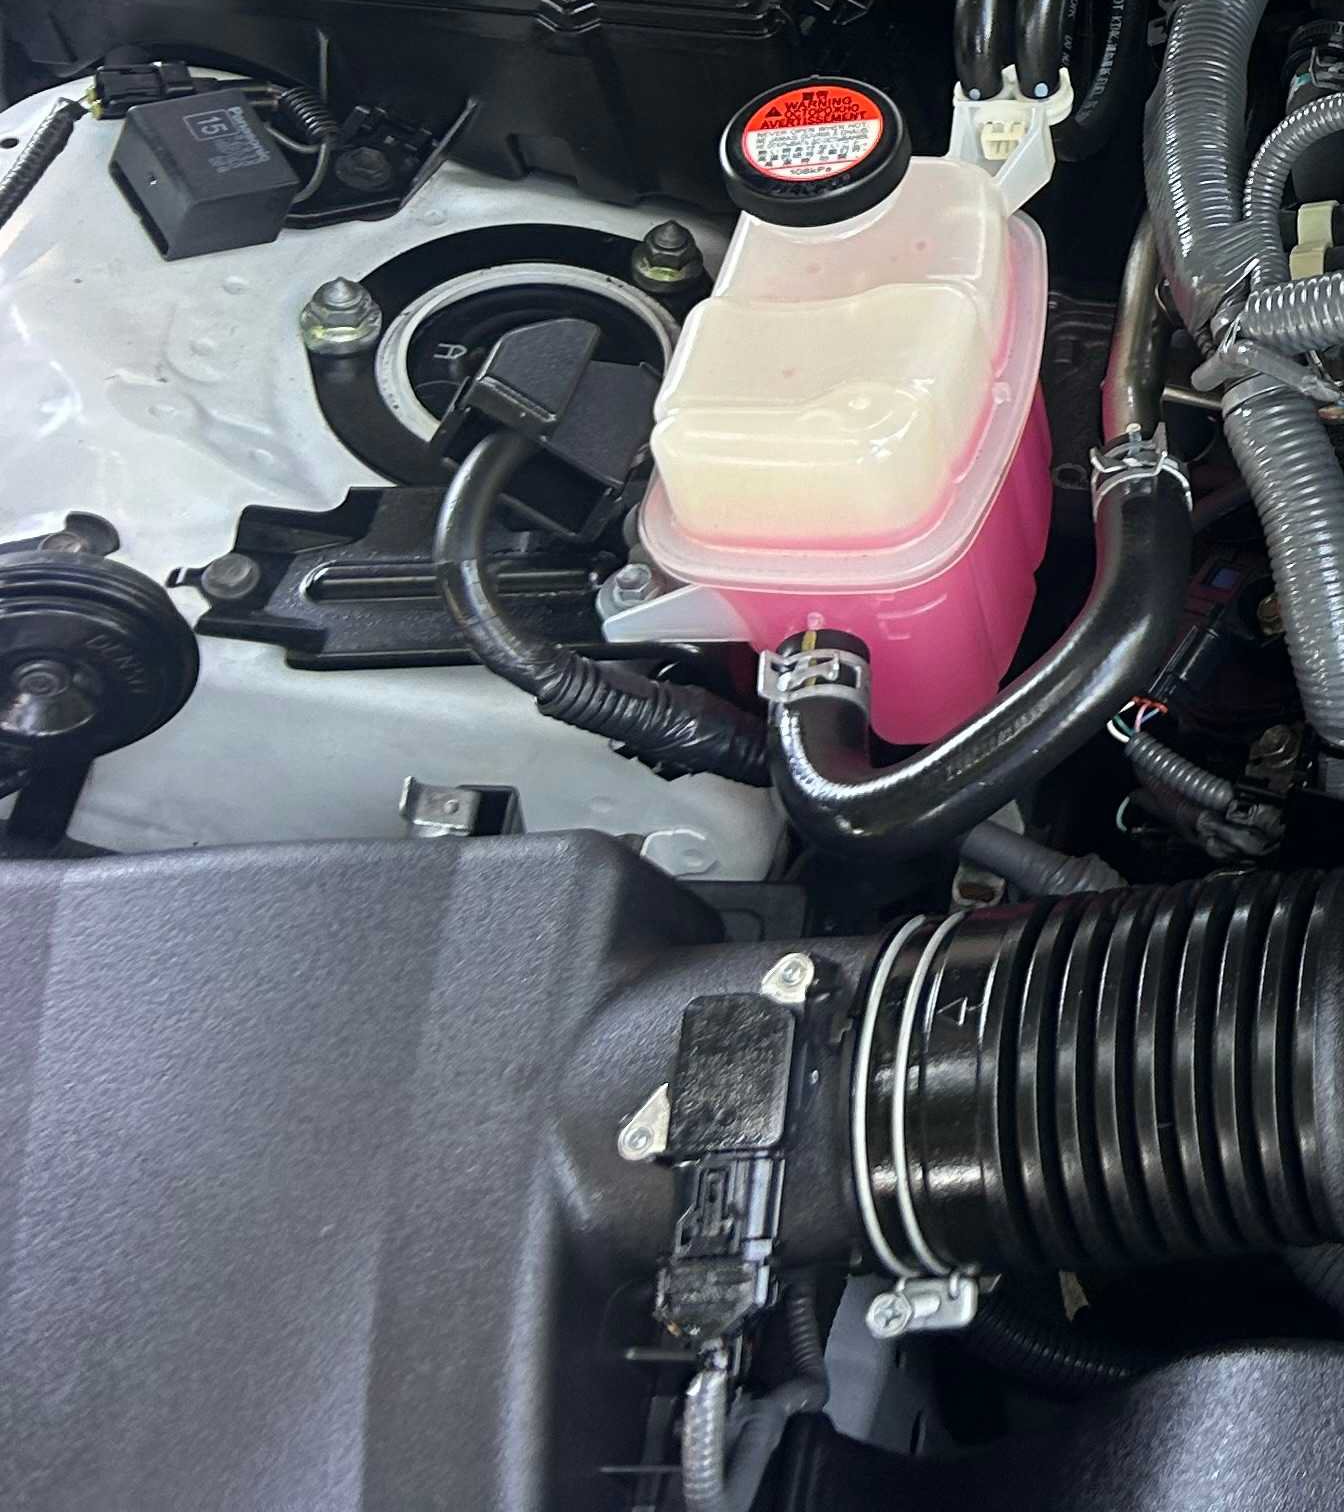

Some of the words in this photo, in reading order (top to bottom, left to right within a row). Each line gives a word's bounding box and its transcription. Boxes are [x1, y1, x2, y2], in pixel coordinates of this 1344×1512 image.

[784, 96, 852, 110] WARNING
[197, 116, 228, 134] 15
[760, 110, 867, 129] AVERTISSEMENT
